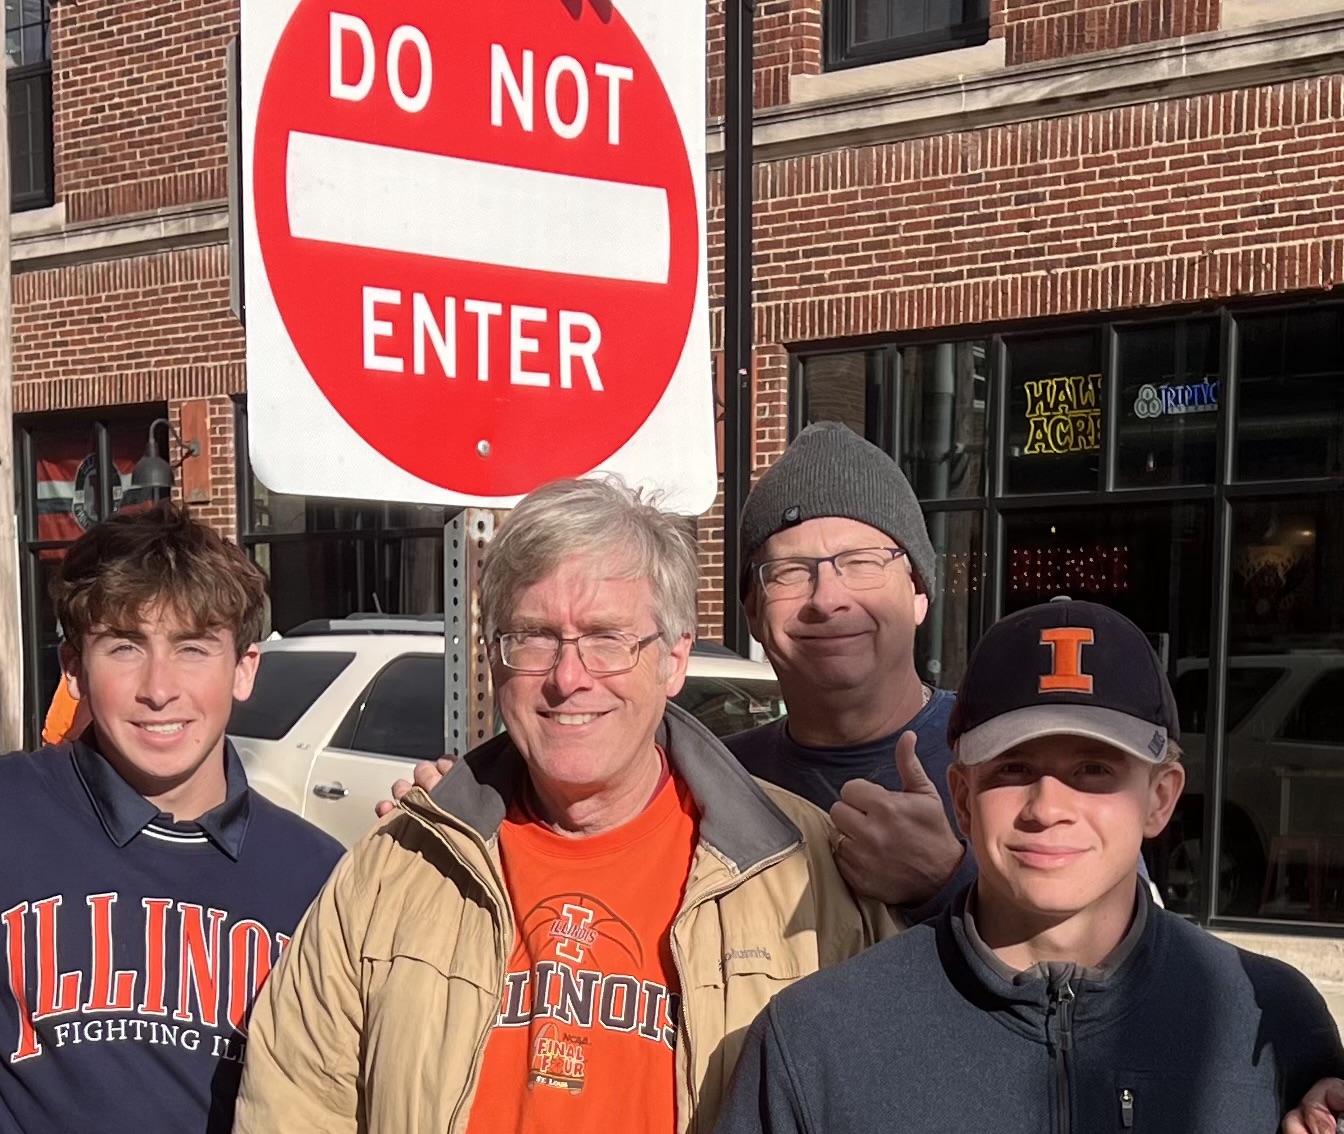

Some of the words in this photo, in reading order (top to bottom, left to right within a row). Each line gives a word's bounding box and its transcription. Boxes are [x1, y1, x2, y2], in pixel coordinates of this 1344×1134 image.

[330, 11, 433, 113] DO
[490, 43, 634, 146] NOT
[362, 285, 605, 392] ENTER
[1038, 626, 1094, 694] I
[548, 919, 600, 946] ILLINOIS
[1, 891, 292, 1063] ILLINO
[54, 1018, 201, 1051] FIGHTING
[536, 1037, 585, 1062] FINAL
